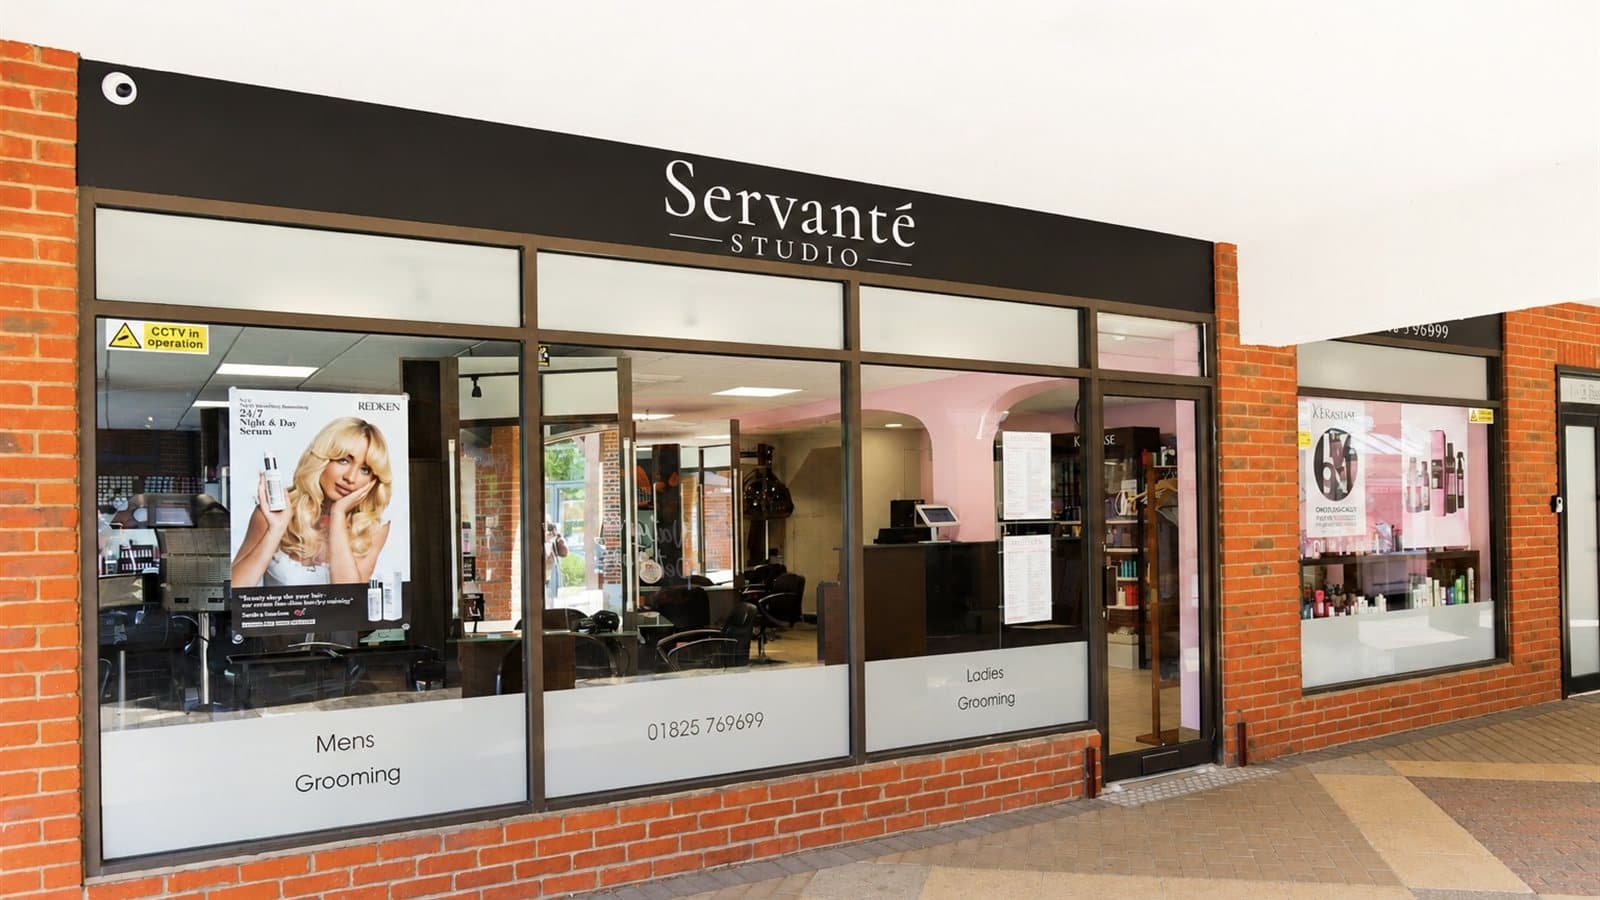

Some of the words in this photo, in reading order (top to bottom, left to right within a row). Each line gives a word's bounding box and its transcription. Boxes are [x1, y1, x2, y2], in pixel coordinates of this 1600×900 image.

[664, 159, 916, 248] Servanté
[730, 233, 859, 267] STUDIO
[151, 326, 186, 337] CCTV
[189, 328, 200, 338] in
[147, 338, 203, 349] operation
[239, 408, 264, 418] 24/7
[358, 401, 401, 411] REDKEN
[239, 418, 265, 428] Night
[268, 418, 276, 427] &
[280, 418, 297, 429] Day
[239, 427, 272, 436] Serum
[966, 666, 1004, 683] Ladies
[957, 692, 1016, 711] Grooming
[647, 718, 700, 741] 01825
[706, 711, 764, 734] 769699
[316, 733, 375, 753] Mens
[295, 766, 401, 793] Grooming
